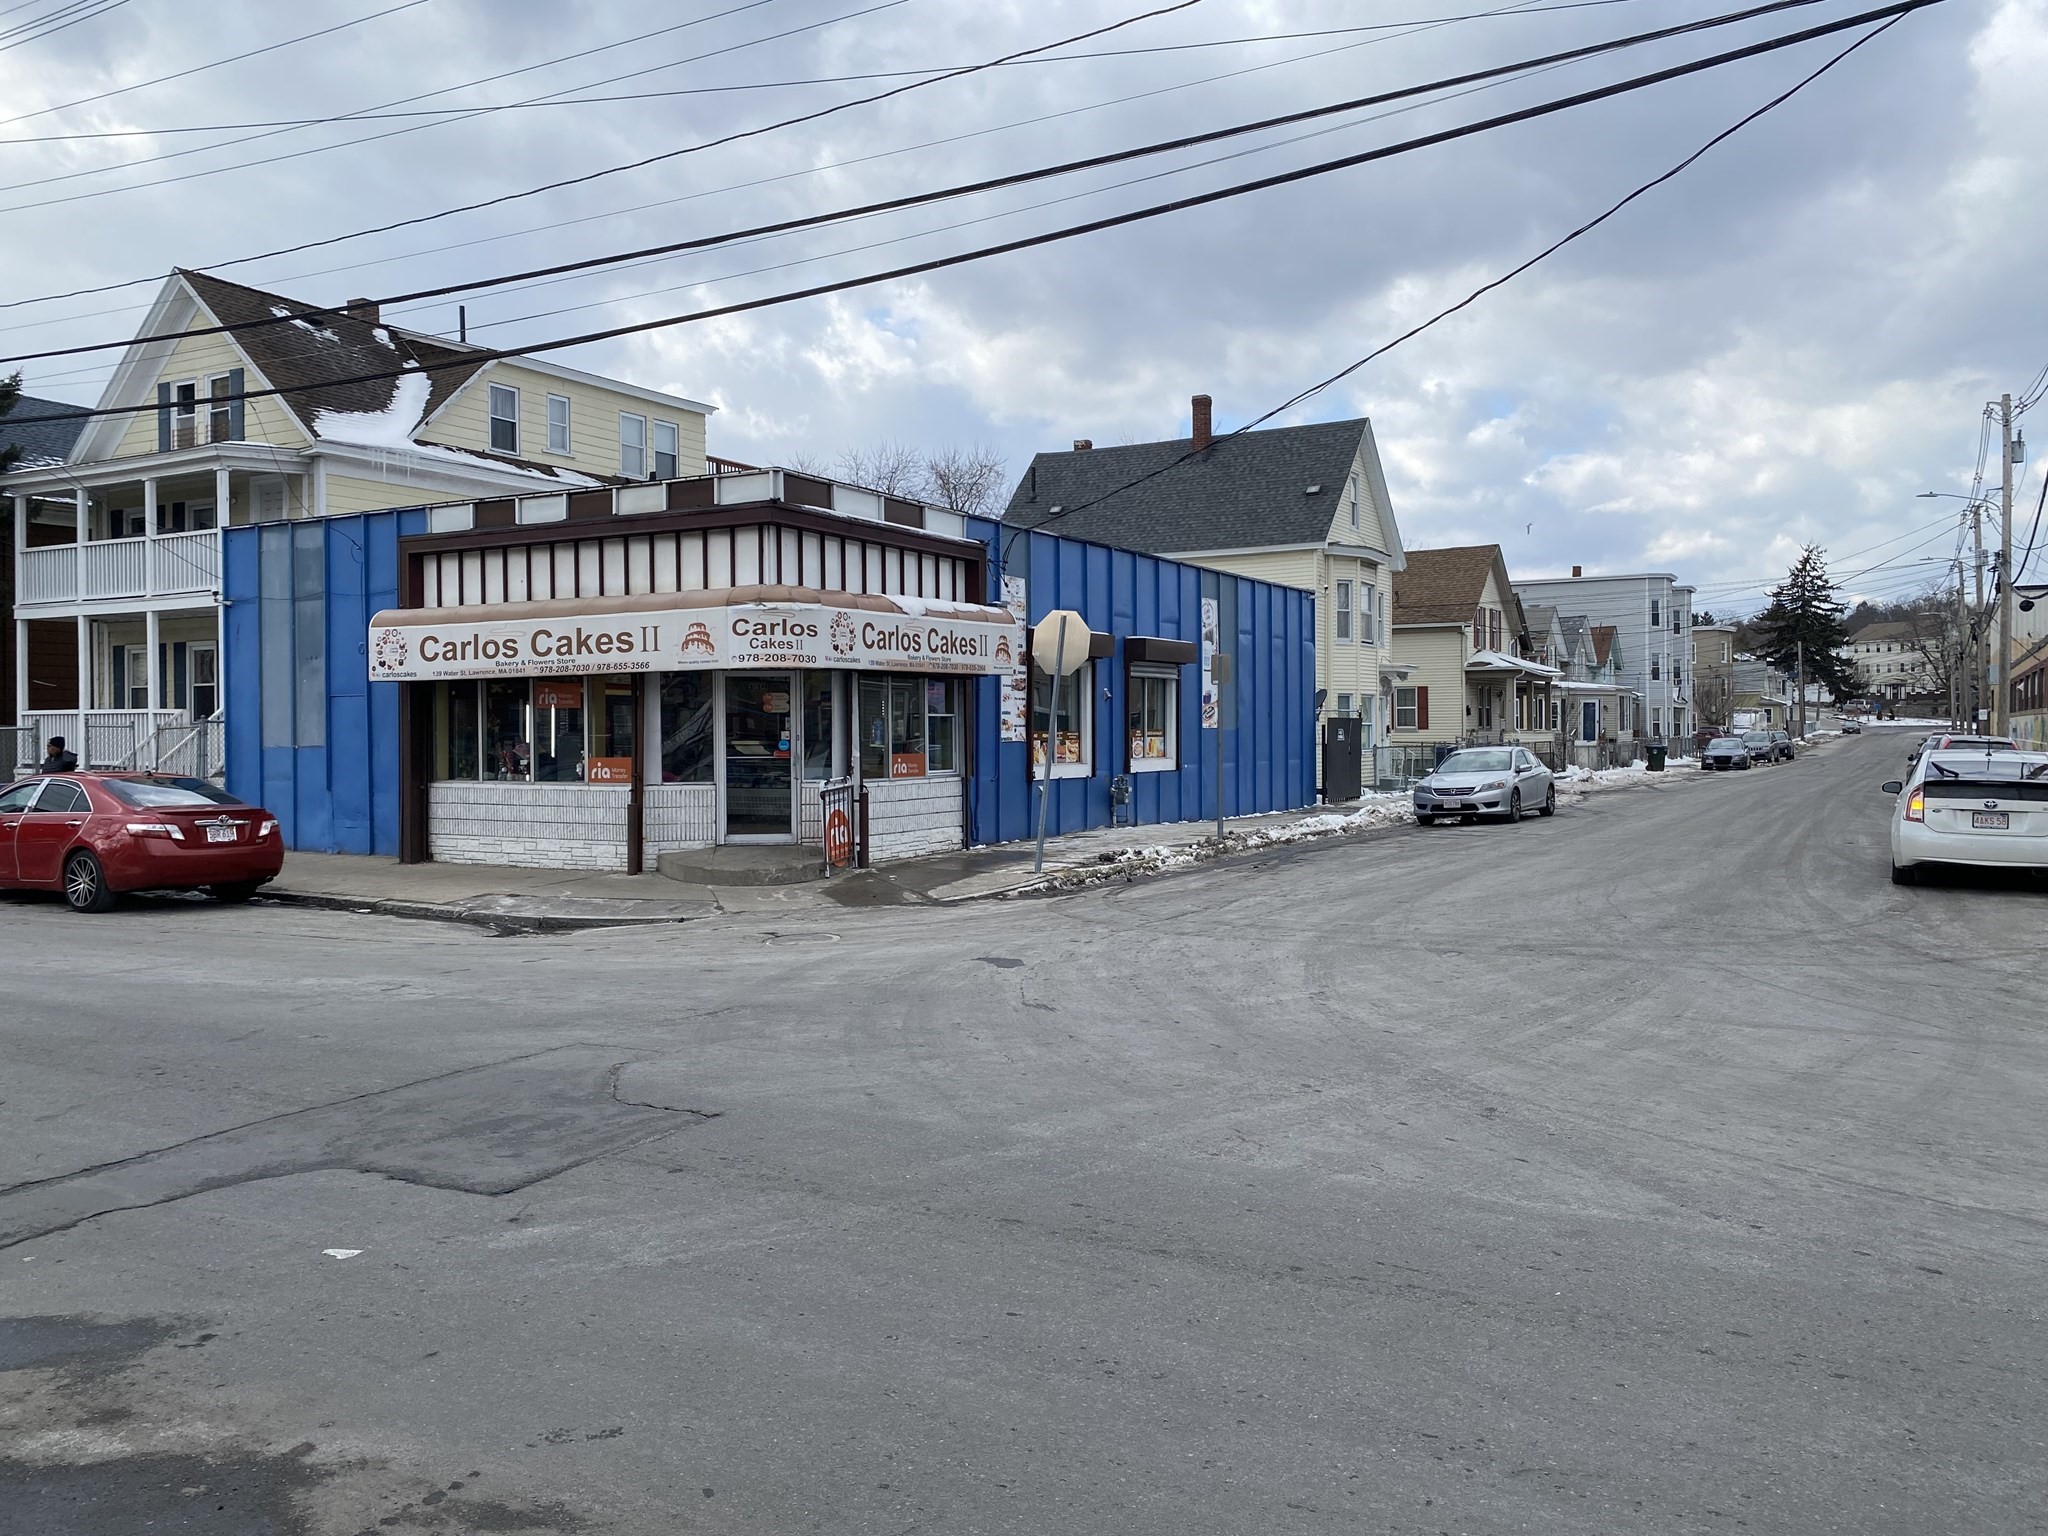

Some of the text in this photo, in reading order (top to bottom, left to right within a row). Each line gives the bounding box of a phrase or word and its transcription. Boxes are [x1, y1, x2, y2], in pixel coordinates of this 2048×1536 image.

[732, 618, 818, 637] Carlos
[419, 625, 661, 662] Carlos Cakes II
[750, 638, 793, 649] Cakes
[862, 622, 988, 657] Carlos Cakes II
[738, 653, 817, 663] 978-208-7030
[833, 656, 861, 664] carloscakes
[539, 664, 590, 674] 978-208-7030
[597, 661, 650, 671] 978-655-3566
[539, 688, 557, 704] ria
[591, 762, 610, 779] ria
[893, 758, 907, 774] ria
